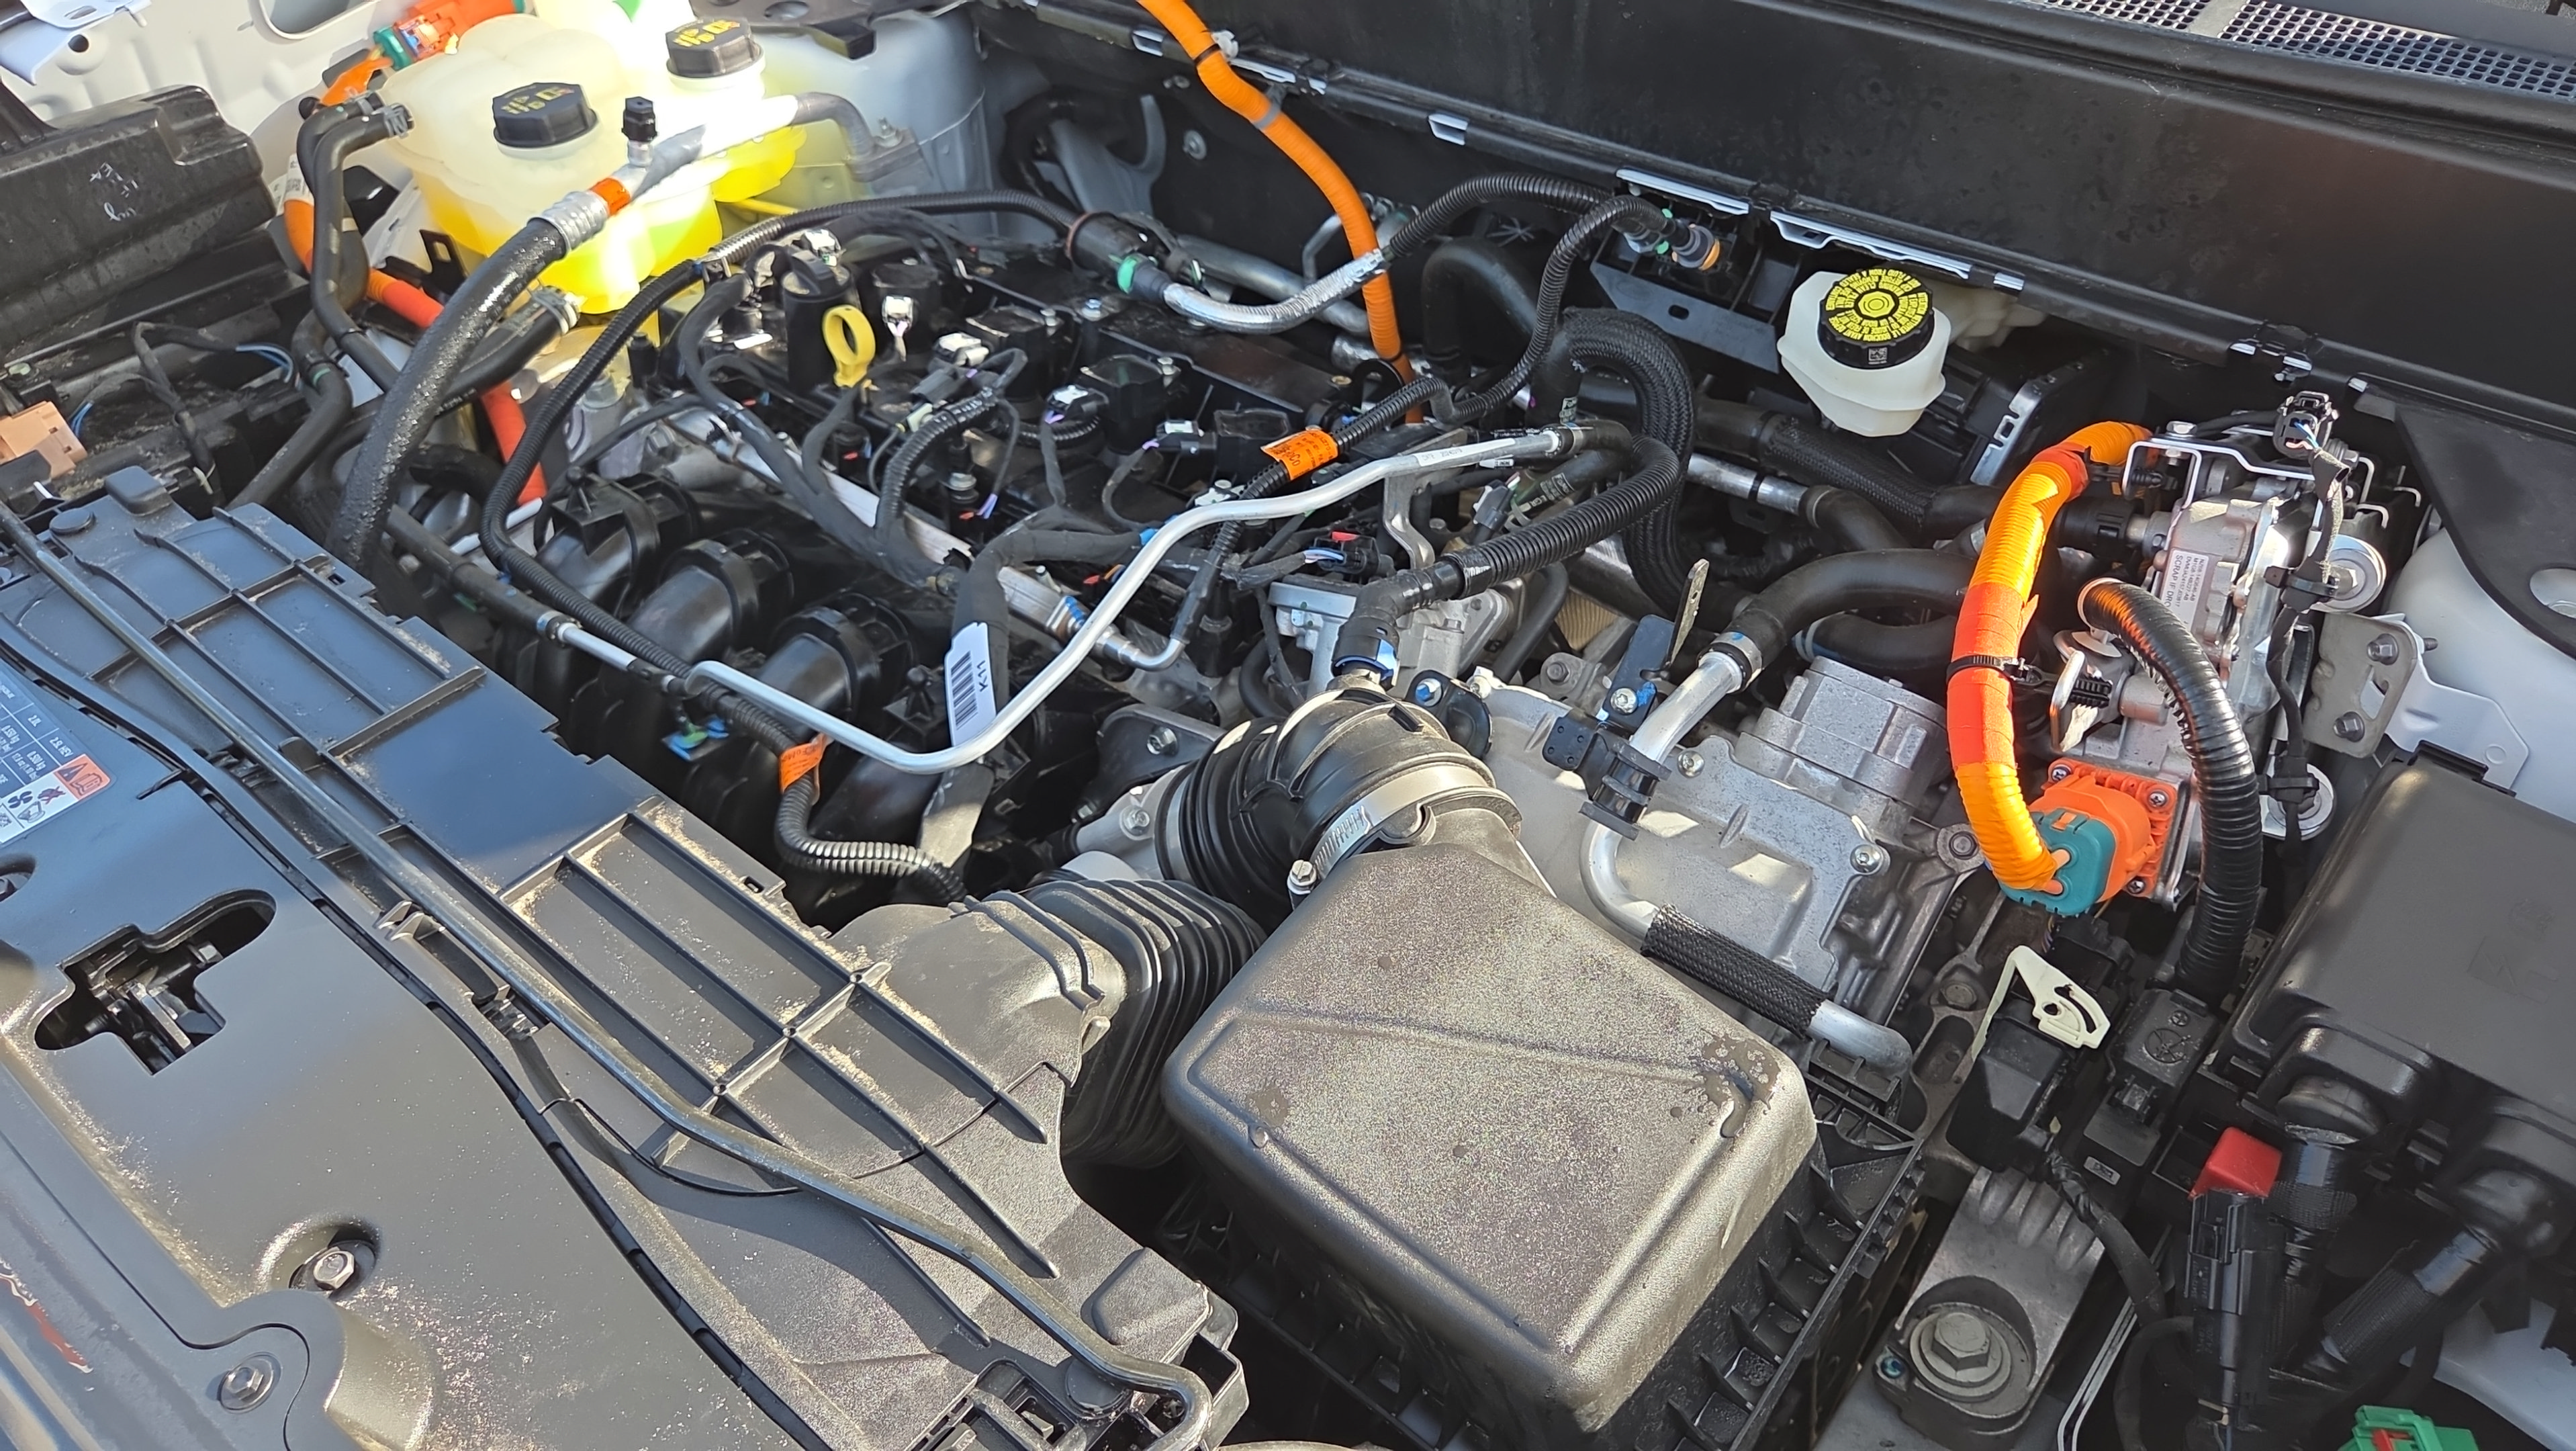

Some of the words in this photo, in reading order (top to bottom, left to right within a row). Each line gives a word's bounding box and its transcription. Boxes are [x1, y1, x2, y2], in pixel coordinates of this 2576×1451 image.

[1529, 494, 1547, 507] EGR
[2170, 554, 2182, 581] SCRAP
[2164, 590, 2174, 607] DRO
[976, 660, 988, 692] K11
[28, 715, 42, 727] 2.0L
[9, 735, 20, 744] kg
[58, 746, 73, 758] HEV
[36, 761, 46, 771] kg
